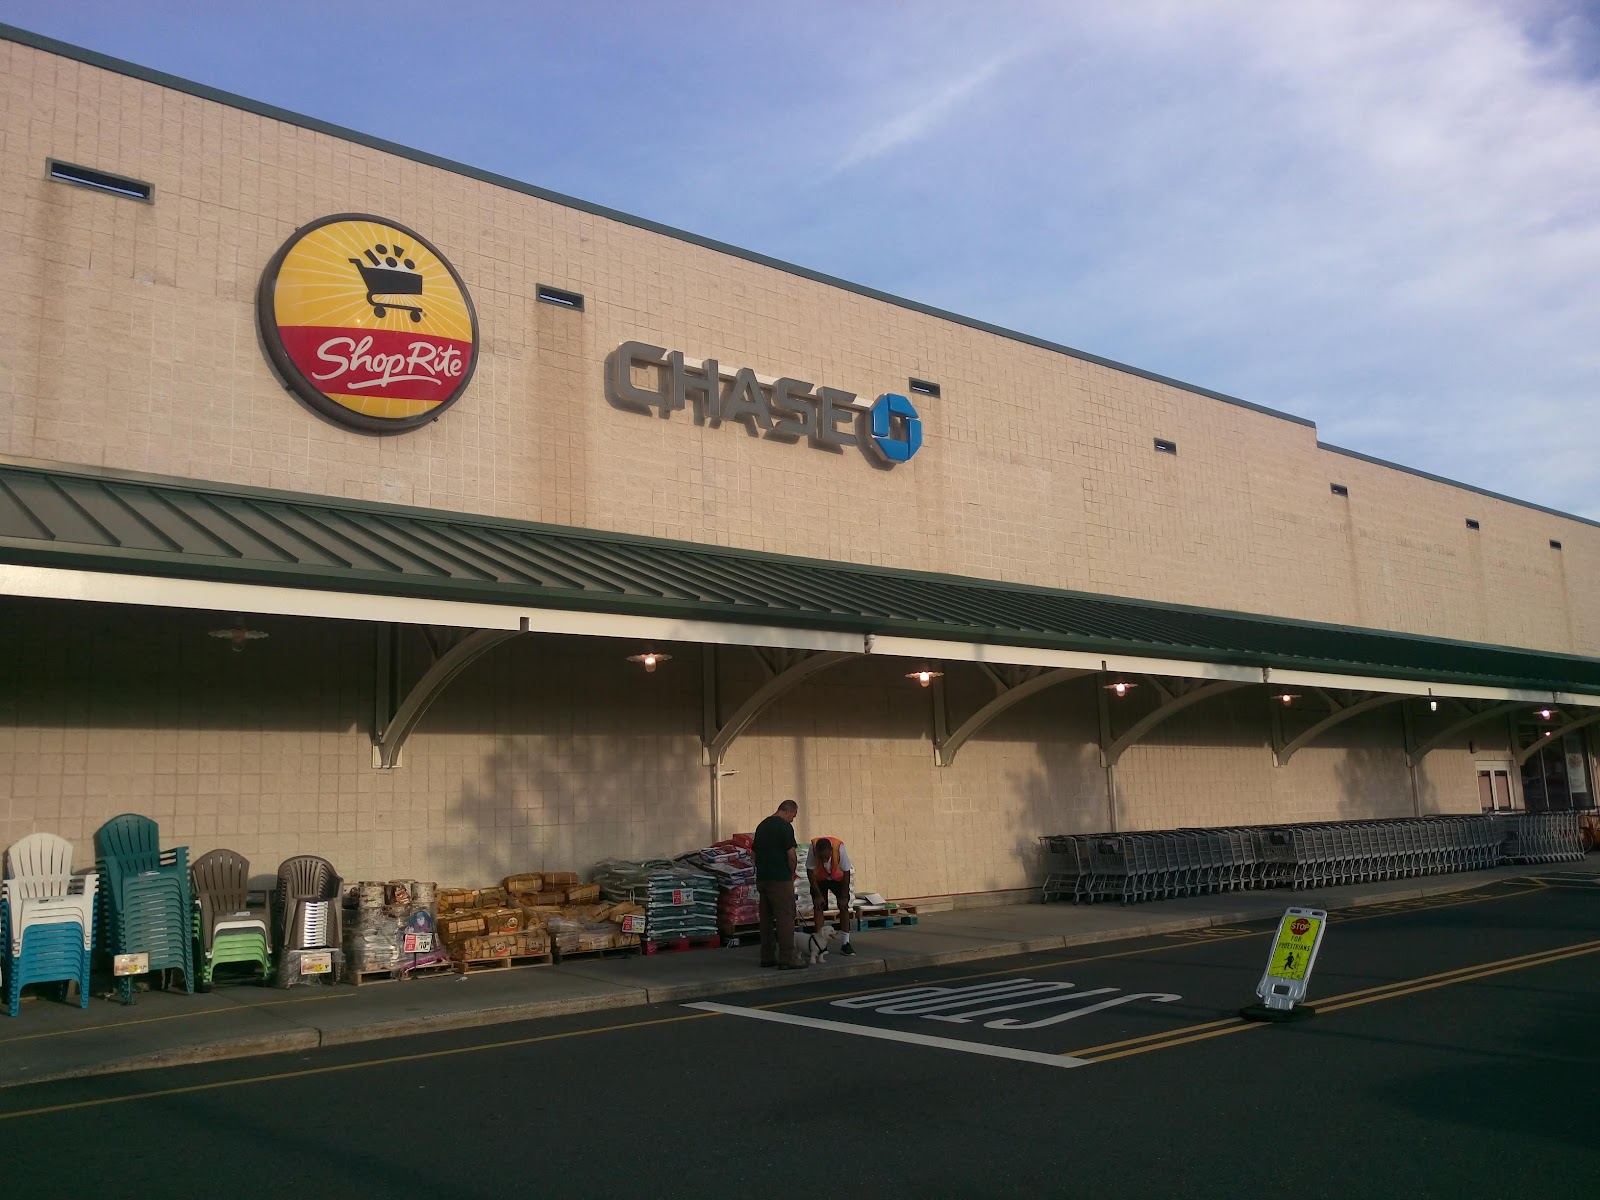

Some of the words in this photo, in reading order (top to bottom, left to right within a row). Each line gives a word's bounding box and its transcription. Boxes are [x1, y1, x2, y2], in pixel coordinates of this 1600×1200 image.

[312, 335, 462, 388] ShopRite
[616, 340, 858, 447] CHASE
[1290, 922, 1310, 931] STOP
[829, 977, 1183, 1030] STOP
